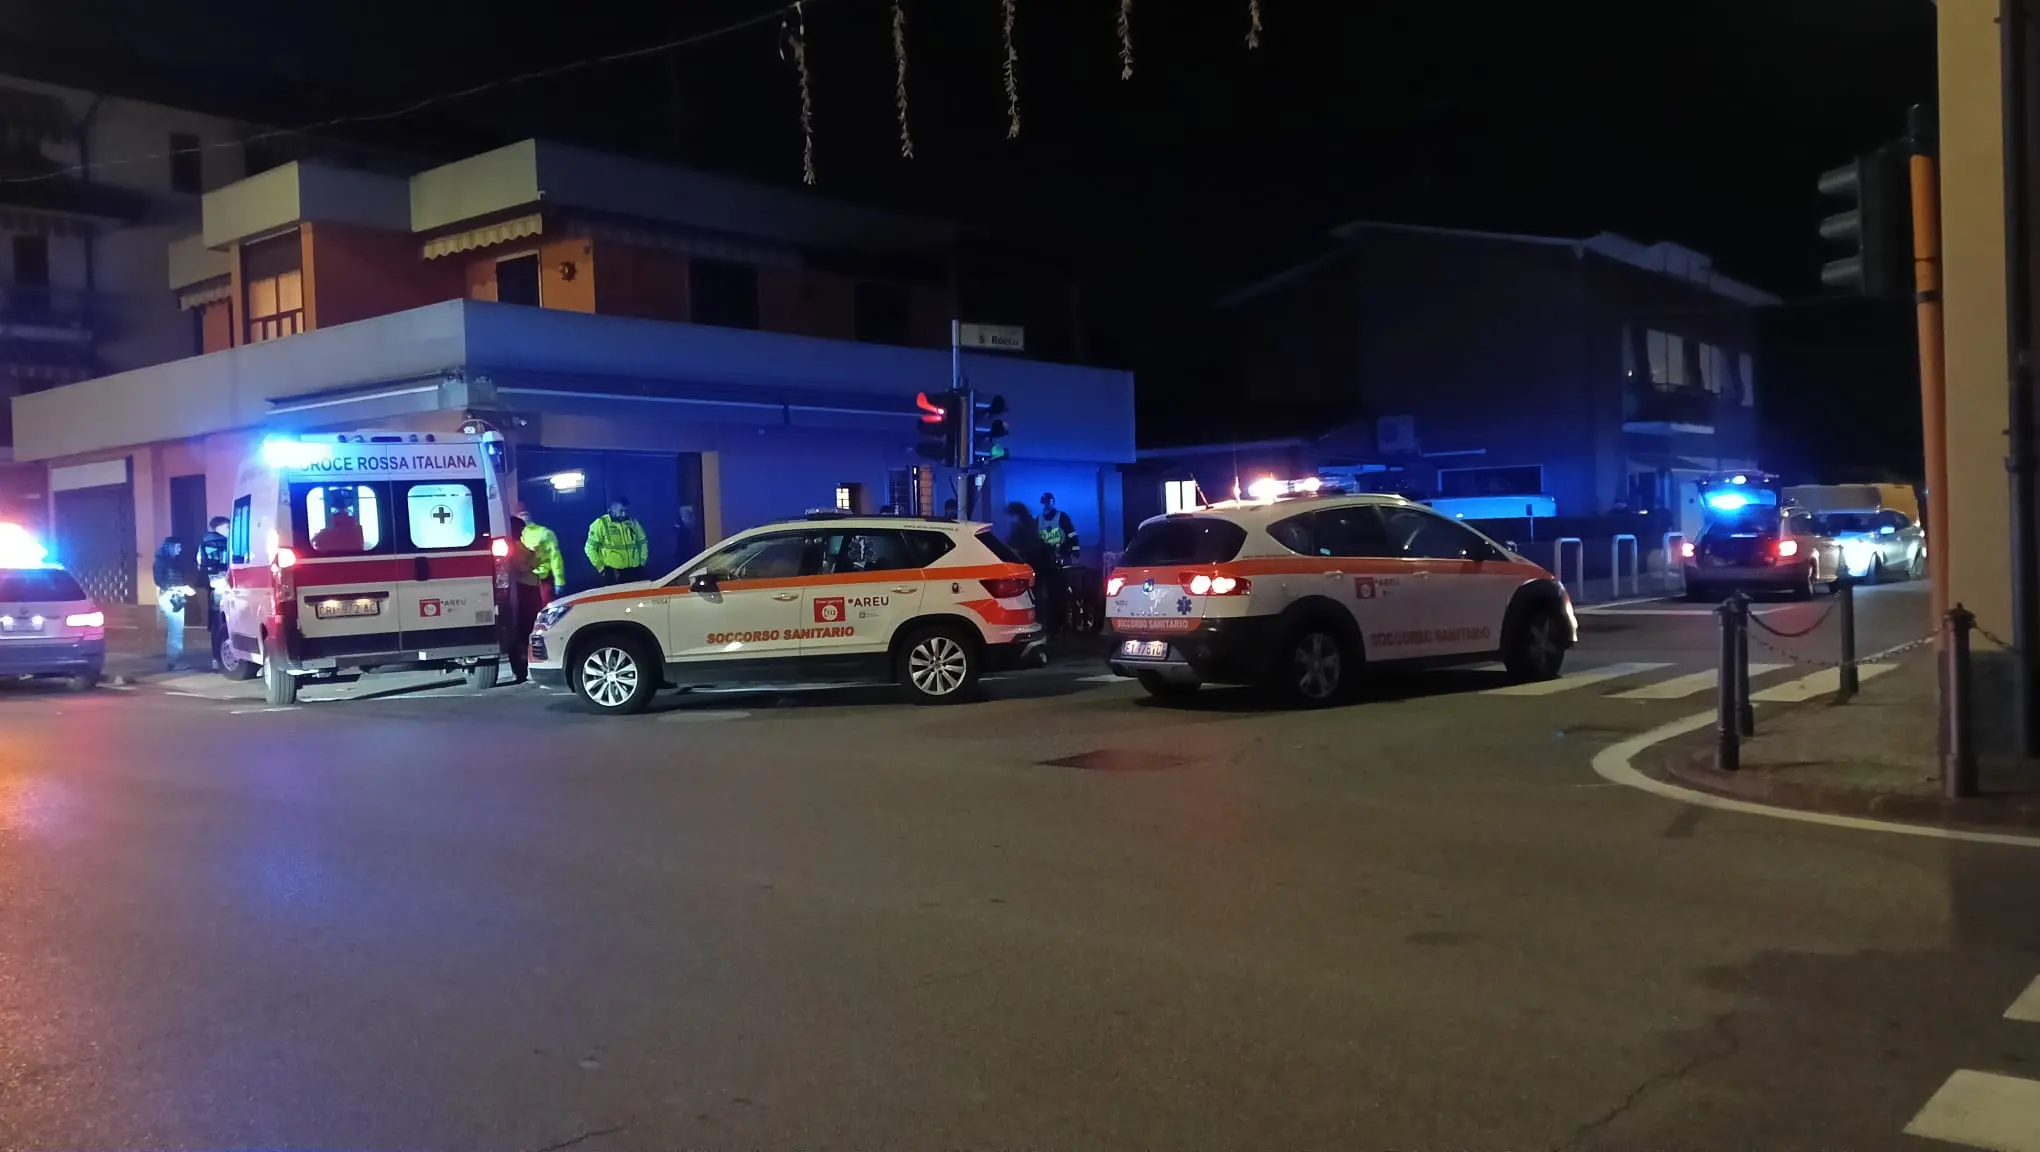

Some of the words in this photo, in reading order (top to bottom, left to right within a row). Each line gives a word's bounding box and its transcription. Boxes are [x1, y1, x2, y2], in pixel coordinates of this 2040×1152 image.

[357, 456, 409, 471] ROSSA
[412, 455, 477, 470] ITALIANA
[854, 596, 889, 607] AREU
[707, 630, 779, 644] SOCCORSO
[784, 626, 854, 640] SANITARIO
